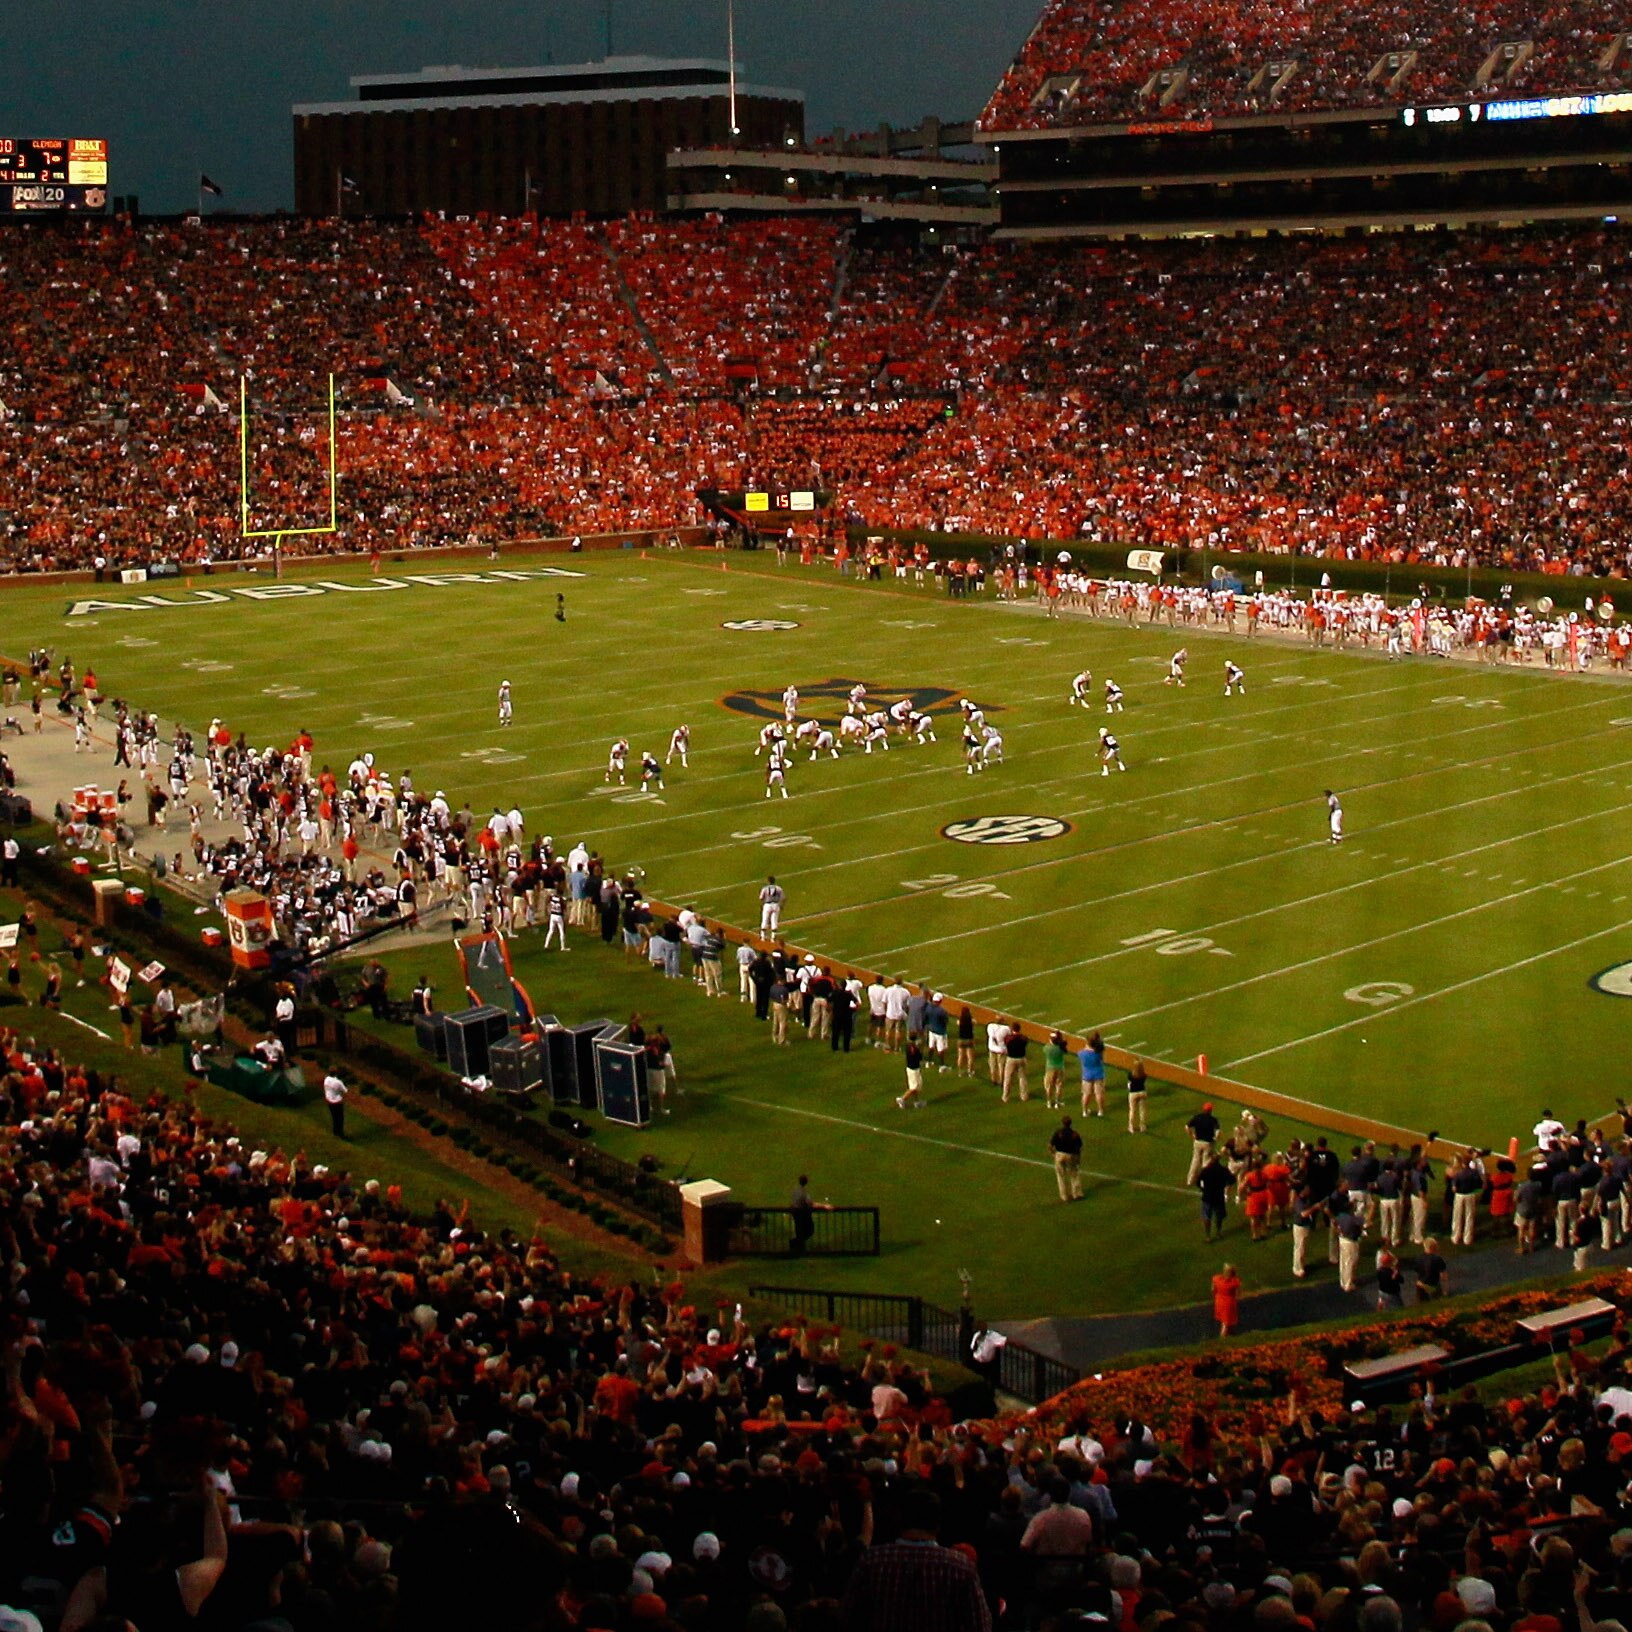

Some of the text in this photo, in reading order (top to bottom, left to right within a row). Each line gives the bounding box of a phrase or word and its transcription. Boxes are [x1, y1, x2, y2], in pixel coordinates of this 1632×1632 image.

[74, 139, 102, 151] BB&T
[18, 154, 25, 167] 3
[42, 151, 51, 165] 7
[41, 169, 49, 181] 2
[14, 187, 65, 201] FOX 20
[776, 494, 789, 507] 15
[69, 567, 588, 616] AUBURN
[730, 825, 813, 849] 30
[945, 816, 1065, 844] SEC
[900, 873, 1001, 900] 20
[1120, 928, 1215, 956] 10
[1343, 980, 1414, 1007] G
[1373, 1448, 1396, 1471] 12
